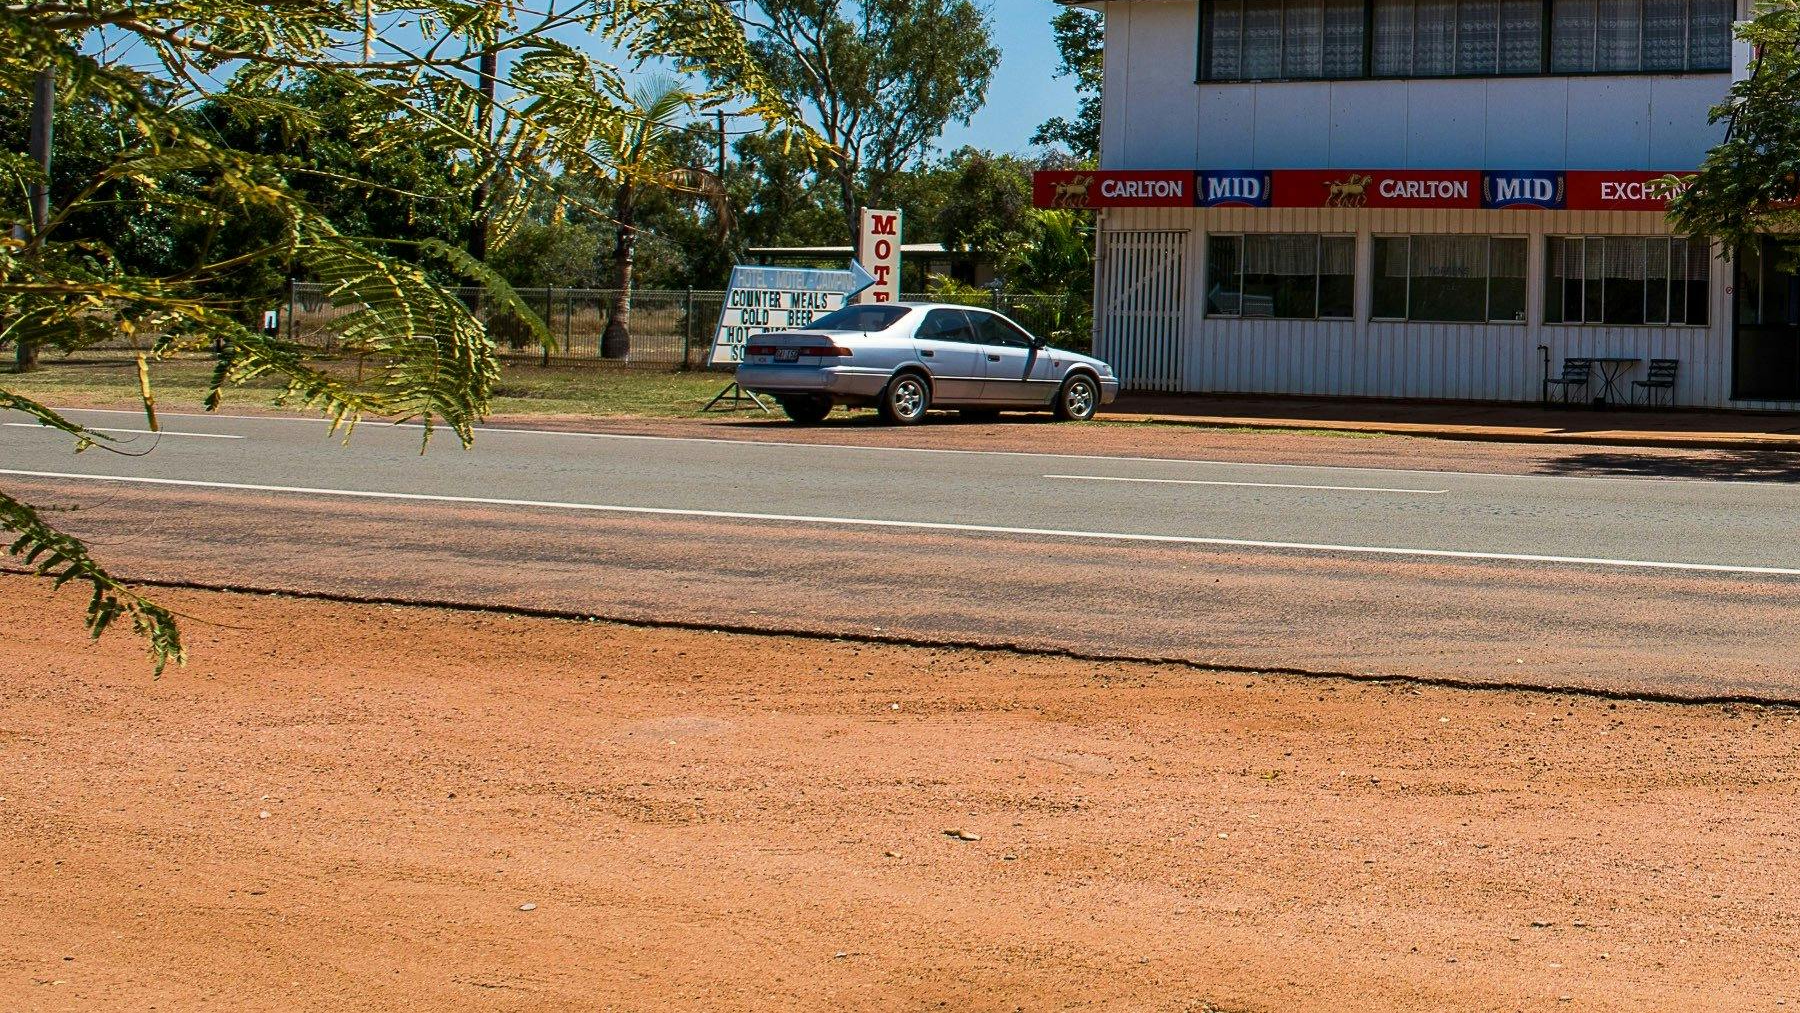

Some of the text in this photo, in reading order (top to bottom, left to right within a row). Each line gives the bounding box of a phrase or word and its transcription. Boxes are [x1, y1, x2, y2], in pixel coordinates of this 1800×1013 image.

[1101, 176, 1260, 200] CARLTON MID
[1379, 177, 1553, 202] CARLTON MID
[1601, 182, 1694, 200] EXCHAN
[871, 214, 897, 303] MOTE
[737, 271, 768, 287] HOTEL
[776, 272, 808, 288] MOTEL
[731, 290, 828, 309] COUNTER MEALS
[741, 309, 814, 326] COLD BEER
[728, 326, 750, 343] HOT
